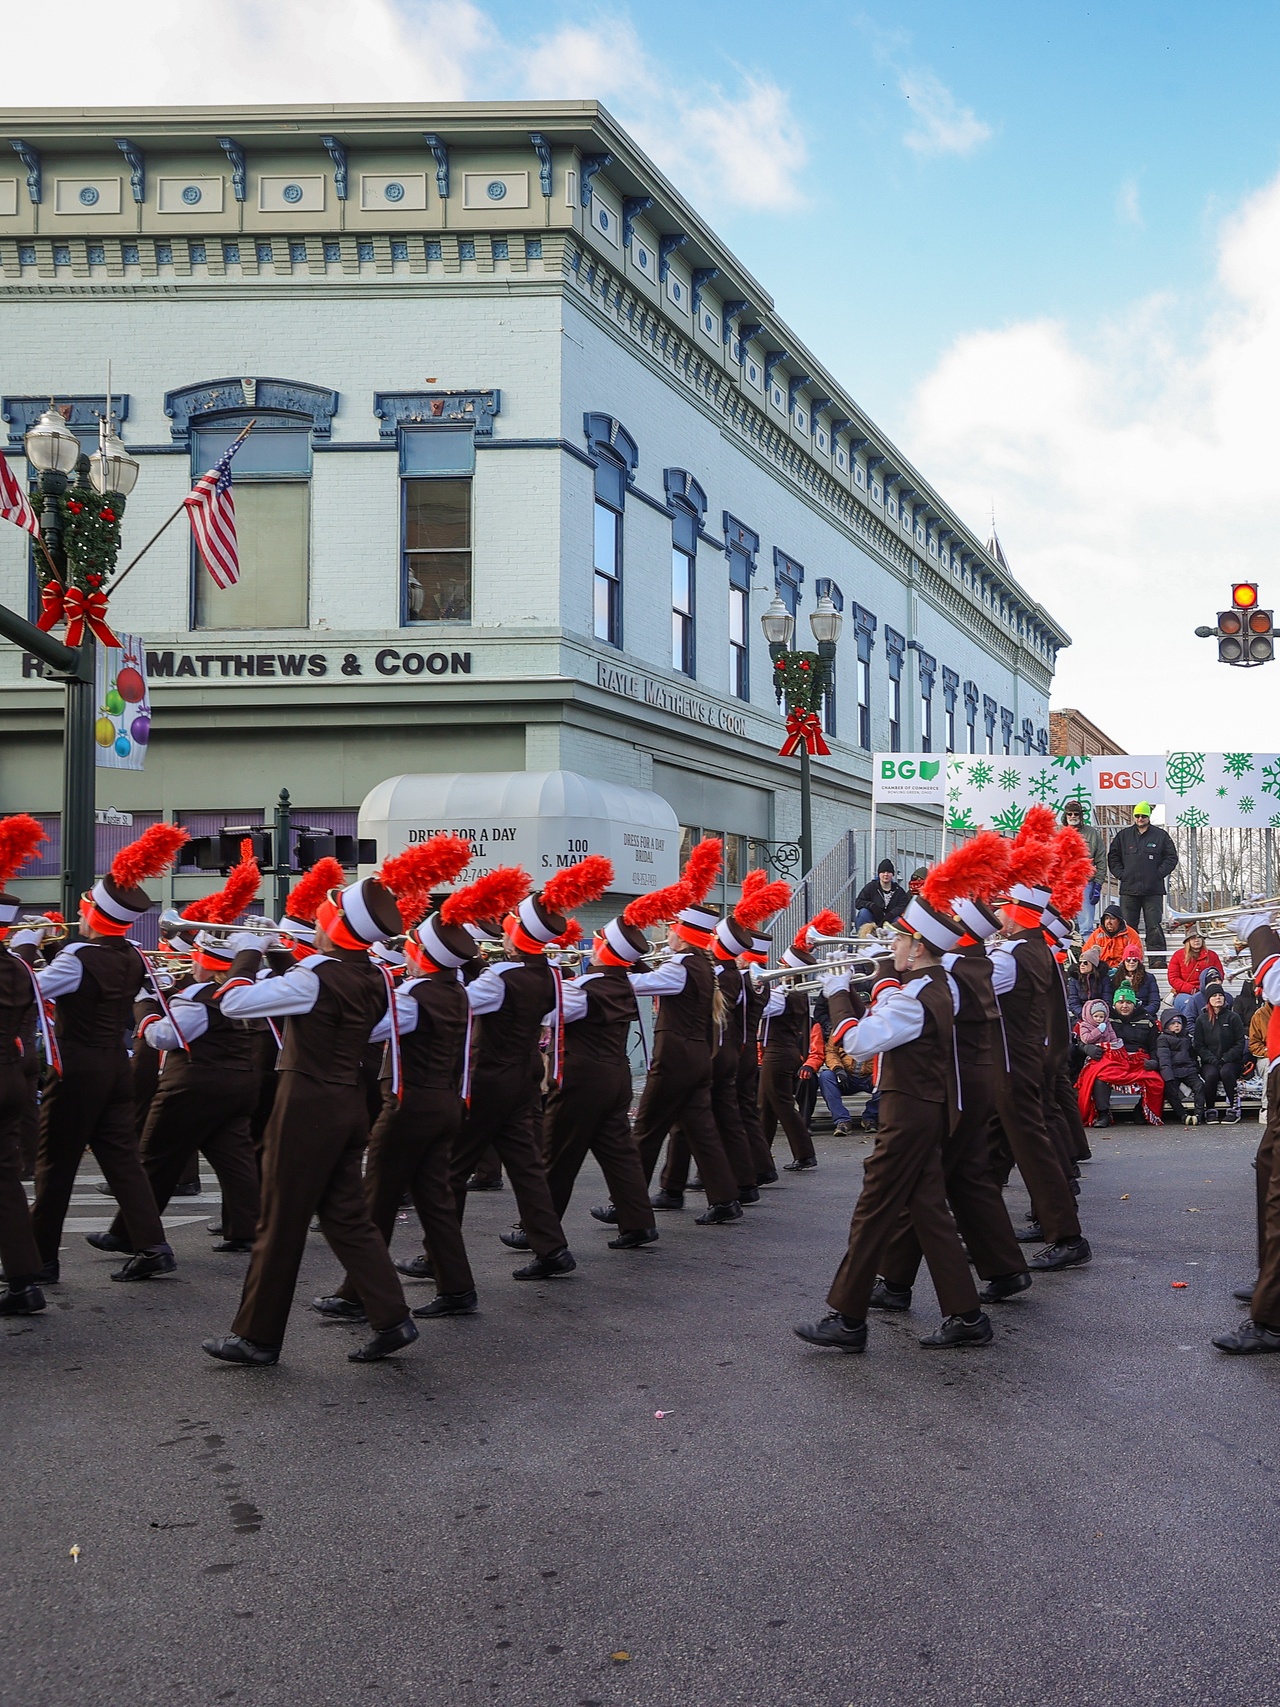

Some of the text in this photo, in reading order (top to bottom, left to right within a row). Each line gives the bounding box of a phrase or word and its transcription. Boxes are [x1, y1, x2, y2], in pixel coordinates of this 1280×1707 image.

[147, 648, 472, 677] MATTHEWS & COON
[597, 661, 745, 736] RAYLE MATTHEWS & COON
[882, 761, 916, 779] BG
[1099, 771, 1157, 790] BGSU
[480, 828, 489, 841] A
[492, 827, 517, 842] DAY
[623, 833, 665, 851] DRESS FOR A DAY
[567, 839, 588, 852] 100
[541, 854, 592, 868] S. MAI
[635, 849, 654, 863] BRIDAL
